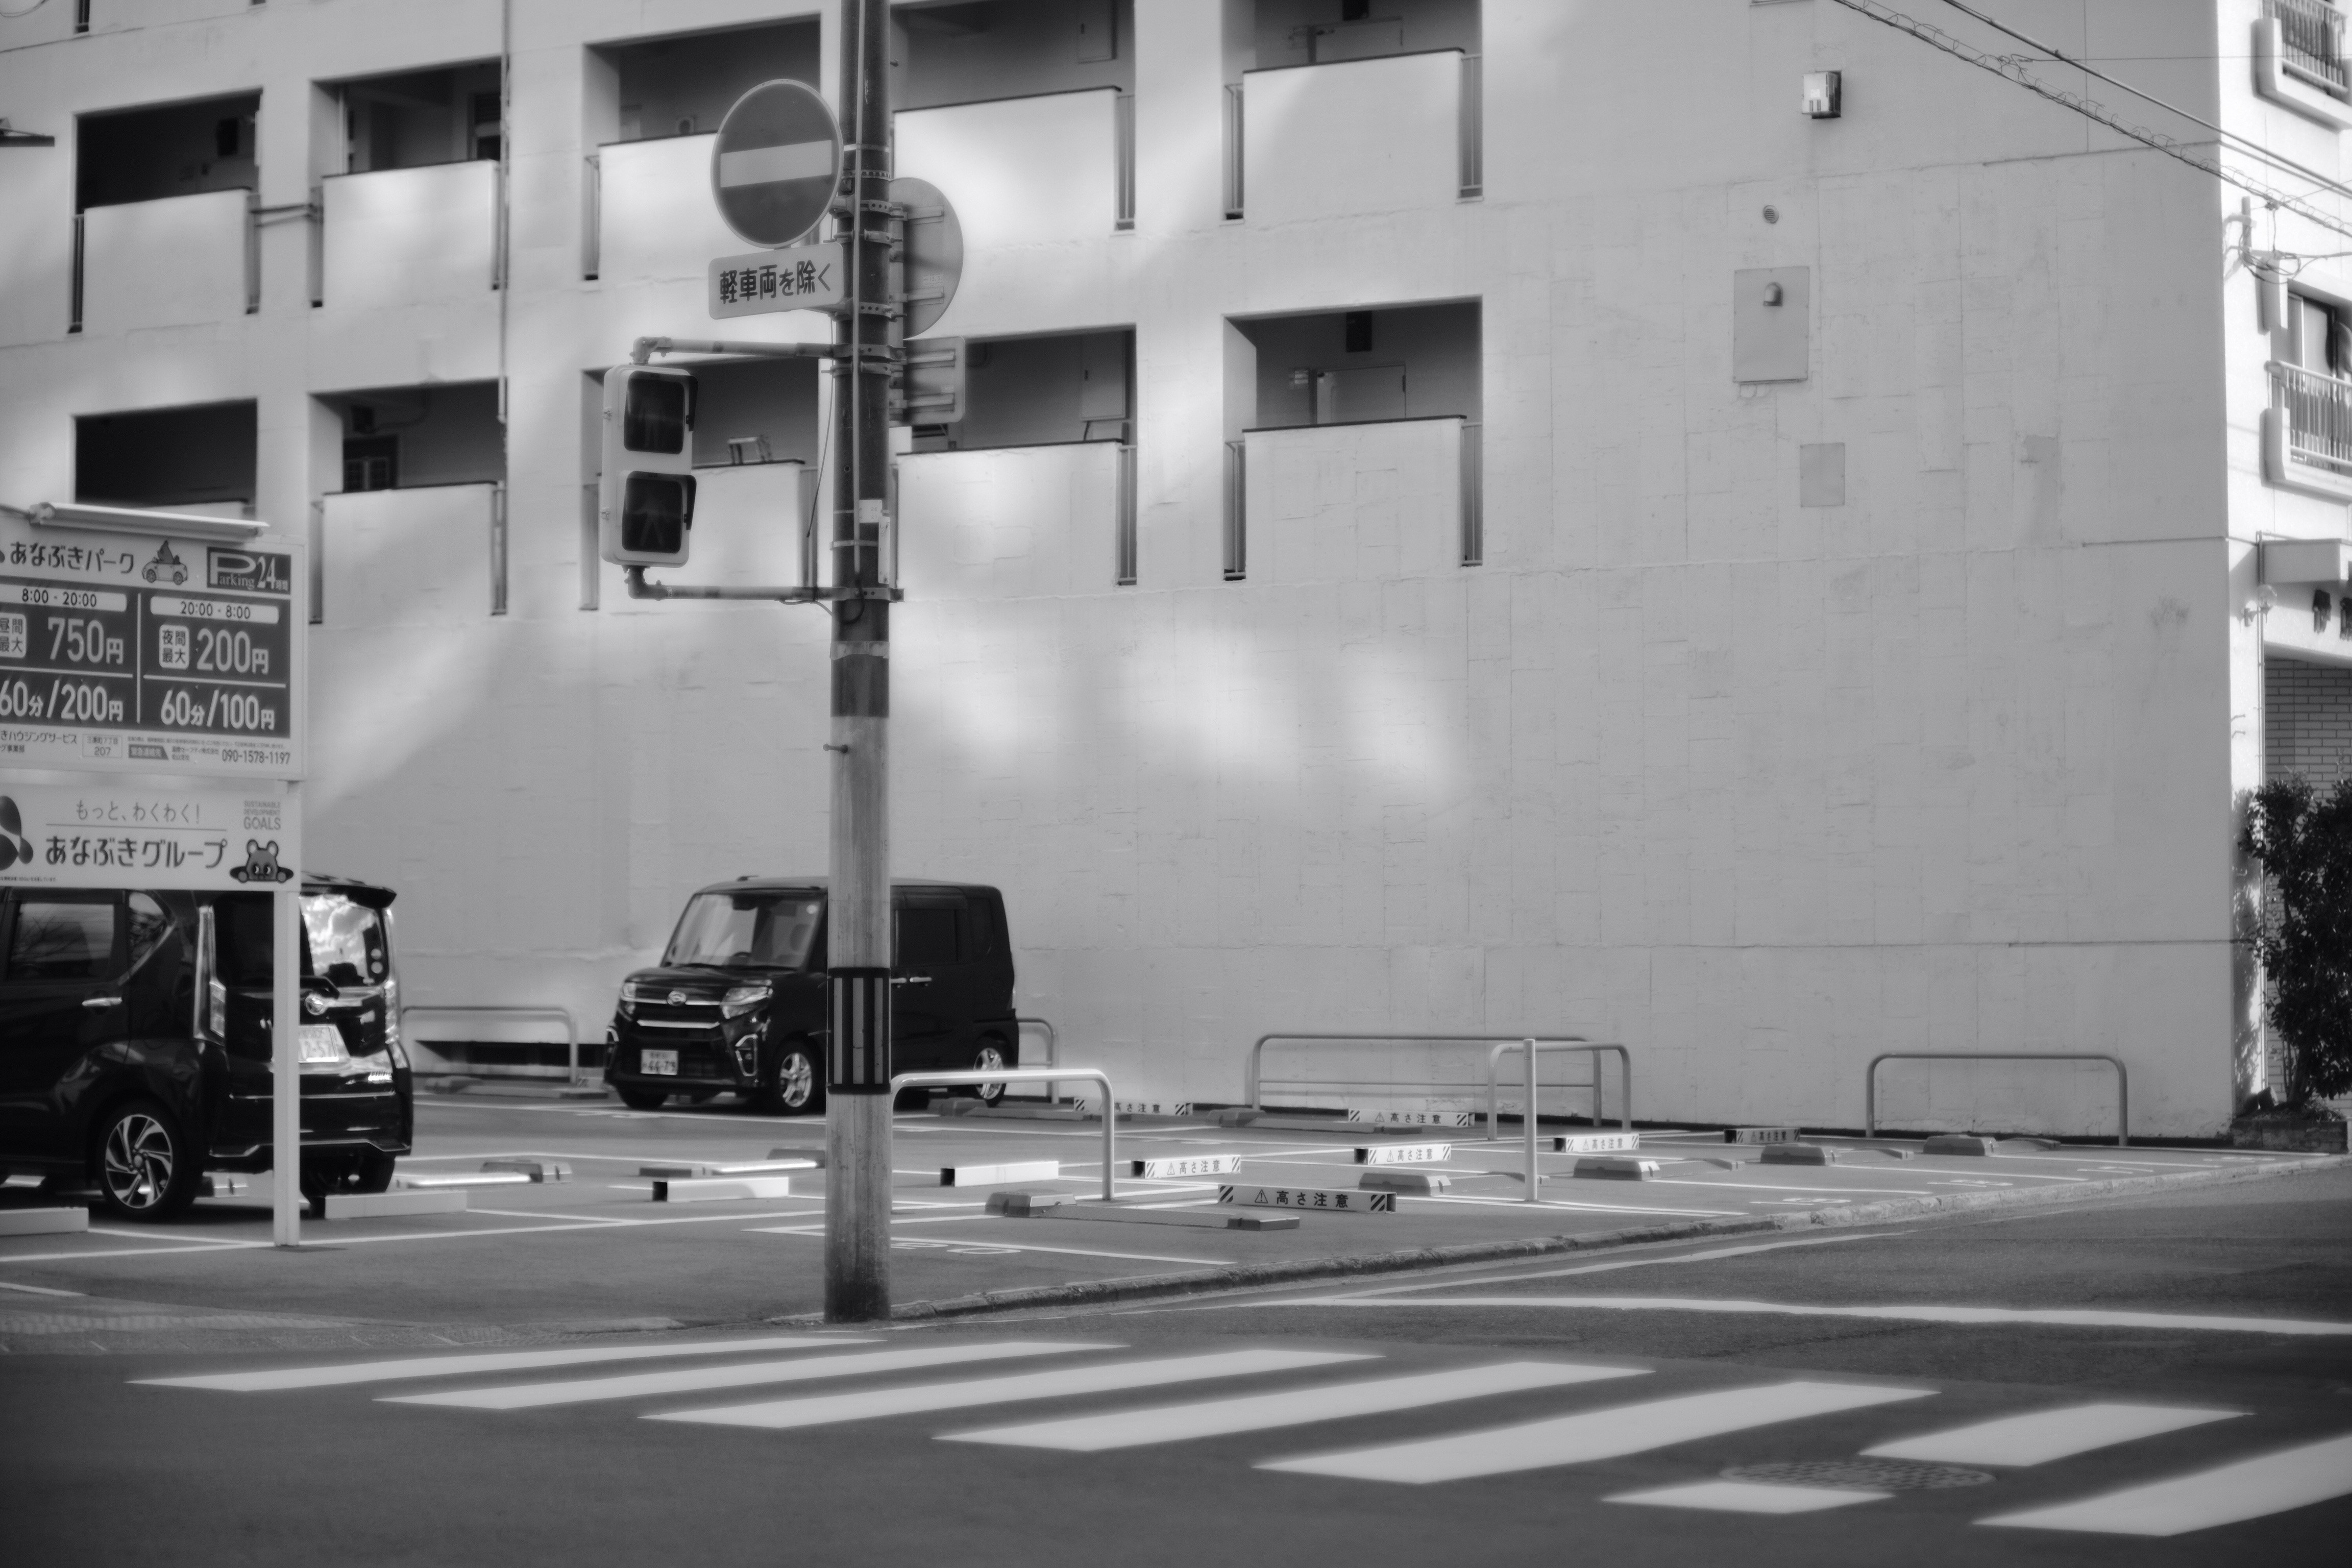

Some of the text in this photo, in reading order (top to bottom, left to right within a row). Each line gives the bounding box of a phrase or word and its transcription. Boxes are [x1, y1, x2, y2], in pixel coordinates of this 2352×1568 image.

[719, 259, 831, 305] 軽車両を除く
[10, 541, 134, 574] あなぶきパーク
[209, 551, 256, 591] Parking
[22, 588, 49, 603] 8:00
[63, 592, 97, 607] 20:00
[180, 601, 213, 617] 20:00
[226, 605, 251, 619] 8:00
[48, 617, 124, 665] 750円
[162, 629, 186, 646] 夜間
[162, 648, 186, 665] 最大
[197, 628, 269, 674] 200円
[0, 679, 124, 722] 60分/200円
[160, 689, 275, 730] 60分/100円
[94, 746, 111, 756] 207
[243, 816, 281, 830] GOALS
[46, 835, 227, 869] あなぶきグループ
[1390, 1113, 1441, 1124] 高さ注意
[1398, 1148, 1433, 1162] 高さ注意
[1179, 1159, 1220, 1174] 高さ注意
[1276, 1190, 1349, 1208] 高さ注意
